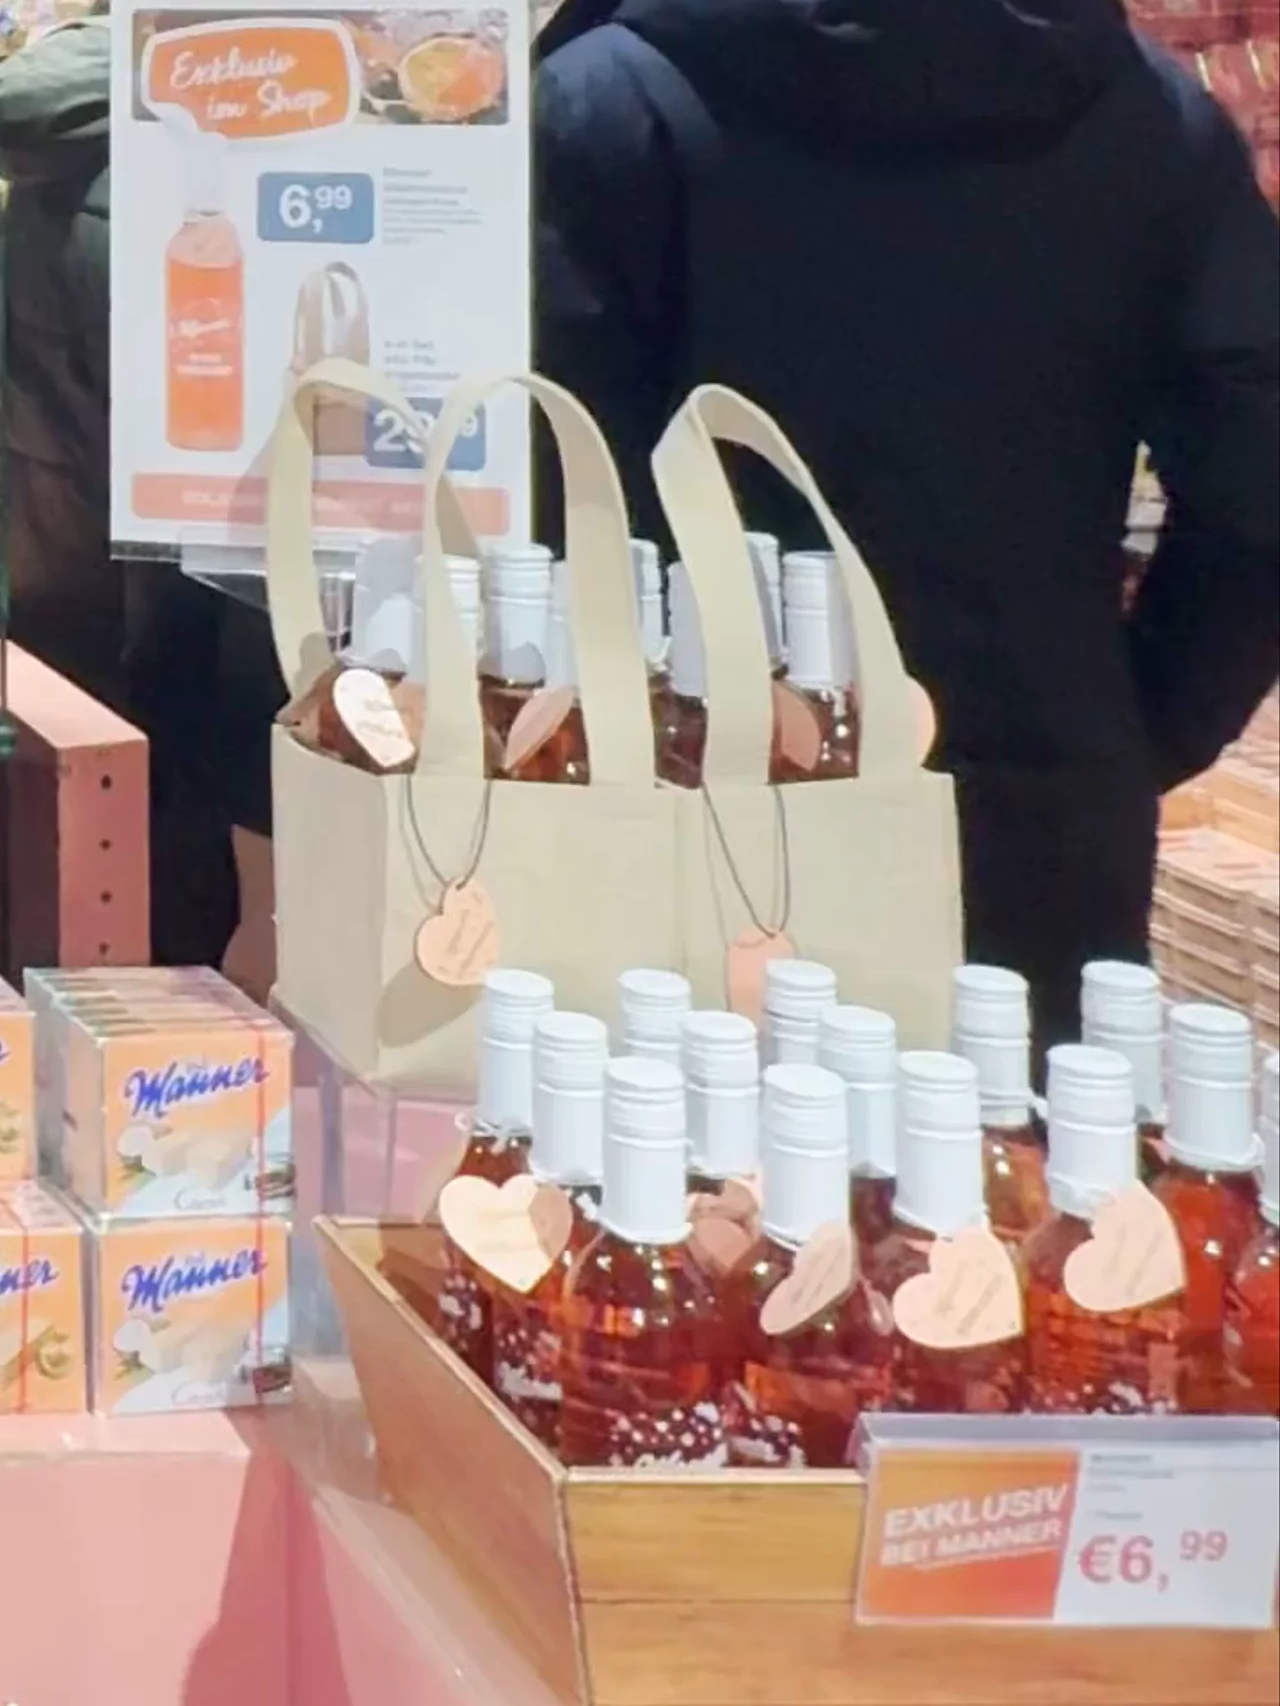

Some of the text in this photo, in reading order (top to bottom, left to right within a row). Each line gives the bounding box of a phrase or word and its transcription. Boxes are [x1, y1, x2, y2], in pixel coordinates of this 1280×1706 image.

[169, 45, 298, 88] Exklusiv
[257, 80, 331, 123] Shop
[278, 184, 354, 234] 6,99
[124, 1057, 270, 1119] Manner
[121, 1249, 269, 1314] Manner
[884, 1484, 1069, 1538] EXKLUSIV
[880, 1519, 1063, 1567] BEI MANNER
